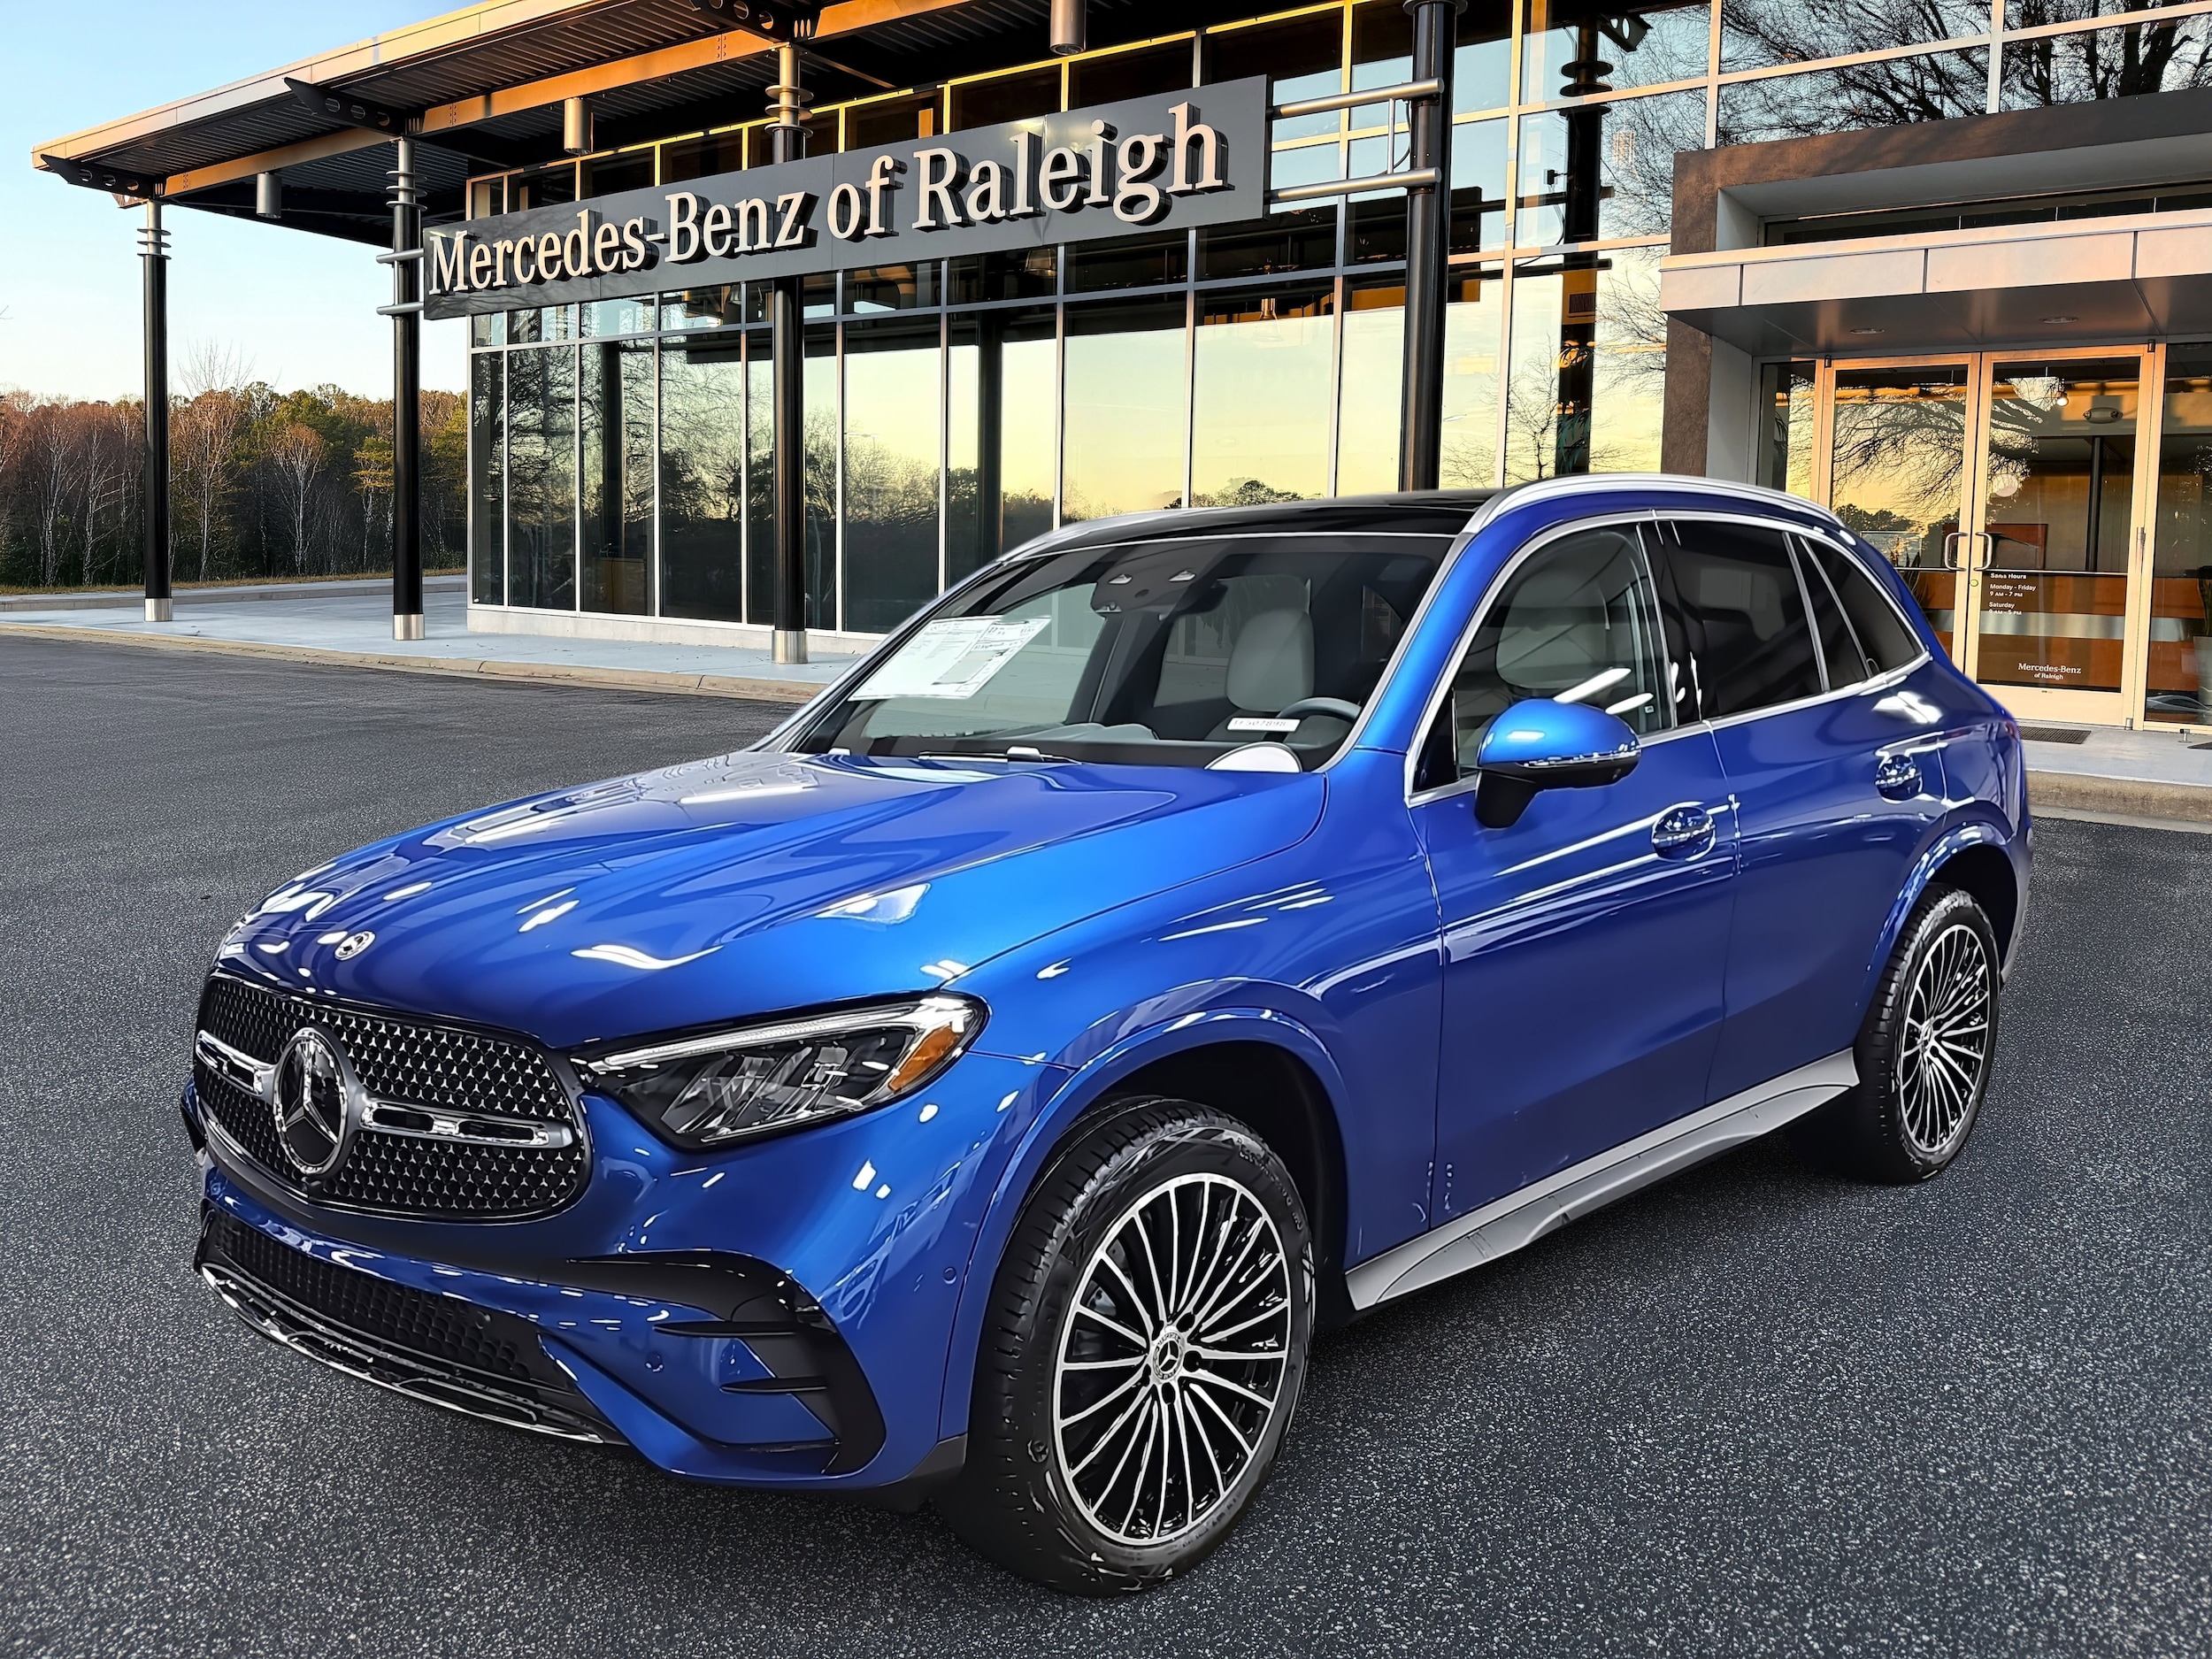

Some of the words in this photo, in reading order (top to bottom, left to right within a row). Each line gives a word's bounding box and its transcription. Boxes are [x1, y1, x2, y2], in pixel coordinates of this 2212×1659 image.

[428, 190, 812, 295] Mercedes-Benz
[827, 154, 899, 241] of
[911, 101, 1228, 223] Raleigh
[2018, 663, 2081, 673] Mercedes-Benz
